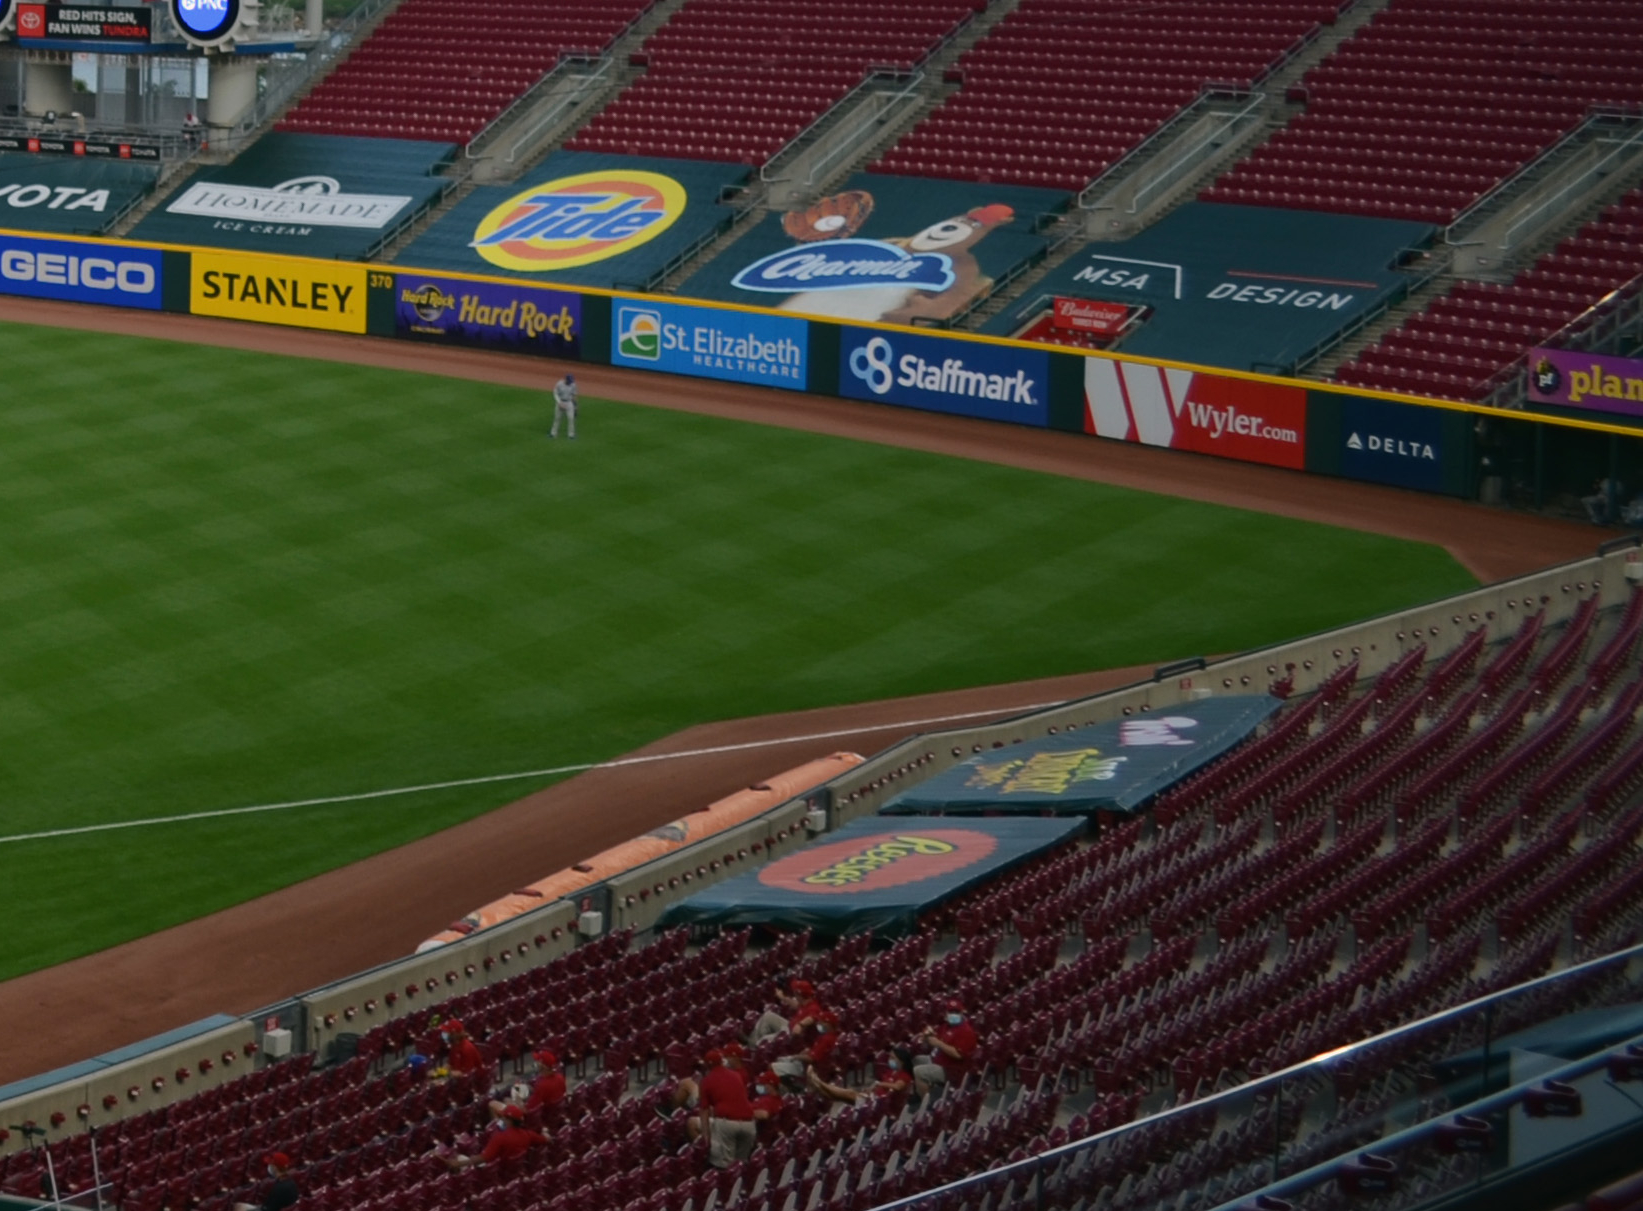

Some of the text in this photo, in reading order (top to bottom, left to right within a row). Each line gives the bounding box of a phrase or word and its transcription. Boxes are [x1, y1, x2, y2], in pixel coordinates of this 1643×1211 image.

[48, 23, 101, 36] FAN WINS
[59, 10, 106, 22] RED HITS
[194, 191, 390, 220] HOMEMADE
[468, 193, 668, 247] Tide
[249, 223, 314, 237] CREAM
[0, 249, 156, 294] GEICO
[370, 275, 393, 289] 370
[1073, 265, 1355, 311] MSA DESIGN
[202, 270, 353, 314] STANLEY
[459, 294, 575, 342] Hard Rock
[662, 325, 801, 365] St. Elizabeth
[693, 354, 801, 379] HEALTHCARE
[898, 355, 1035, 404] Staffmark
[1187, 400, 1298, 444] Wyler.com
[1367, 434, 1435, 460] DELTA
